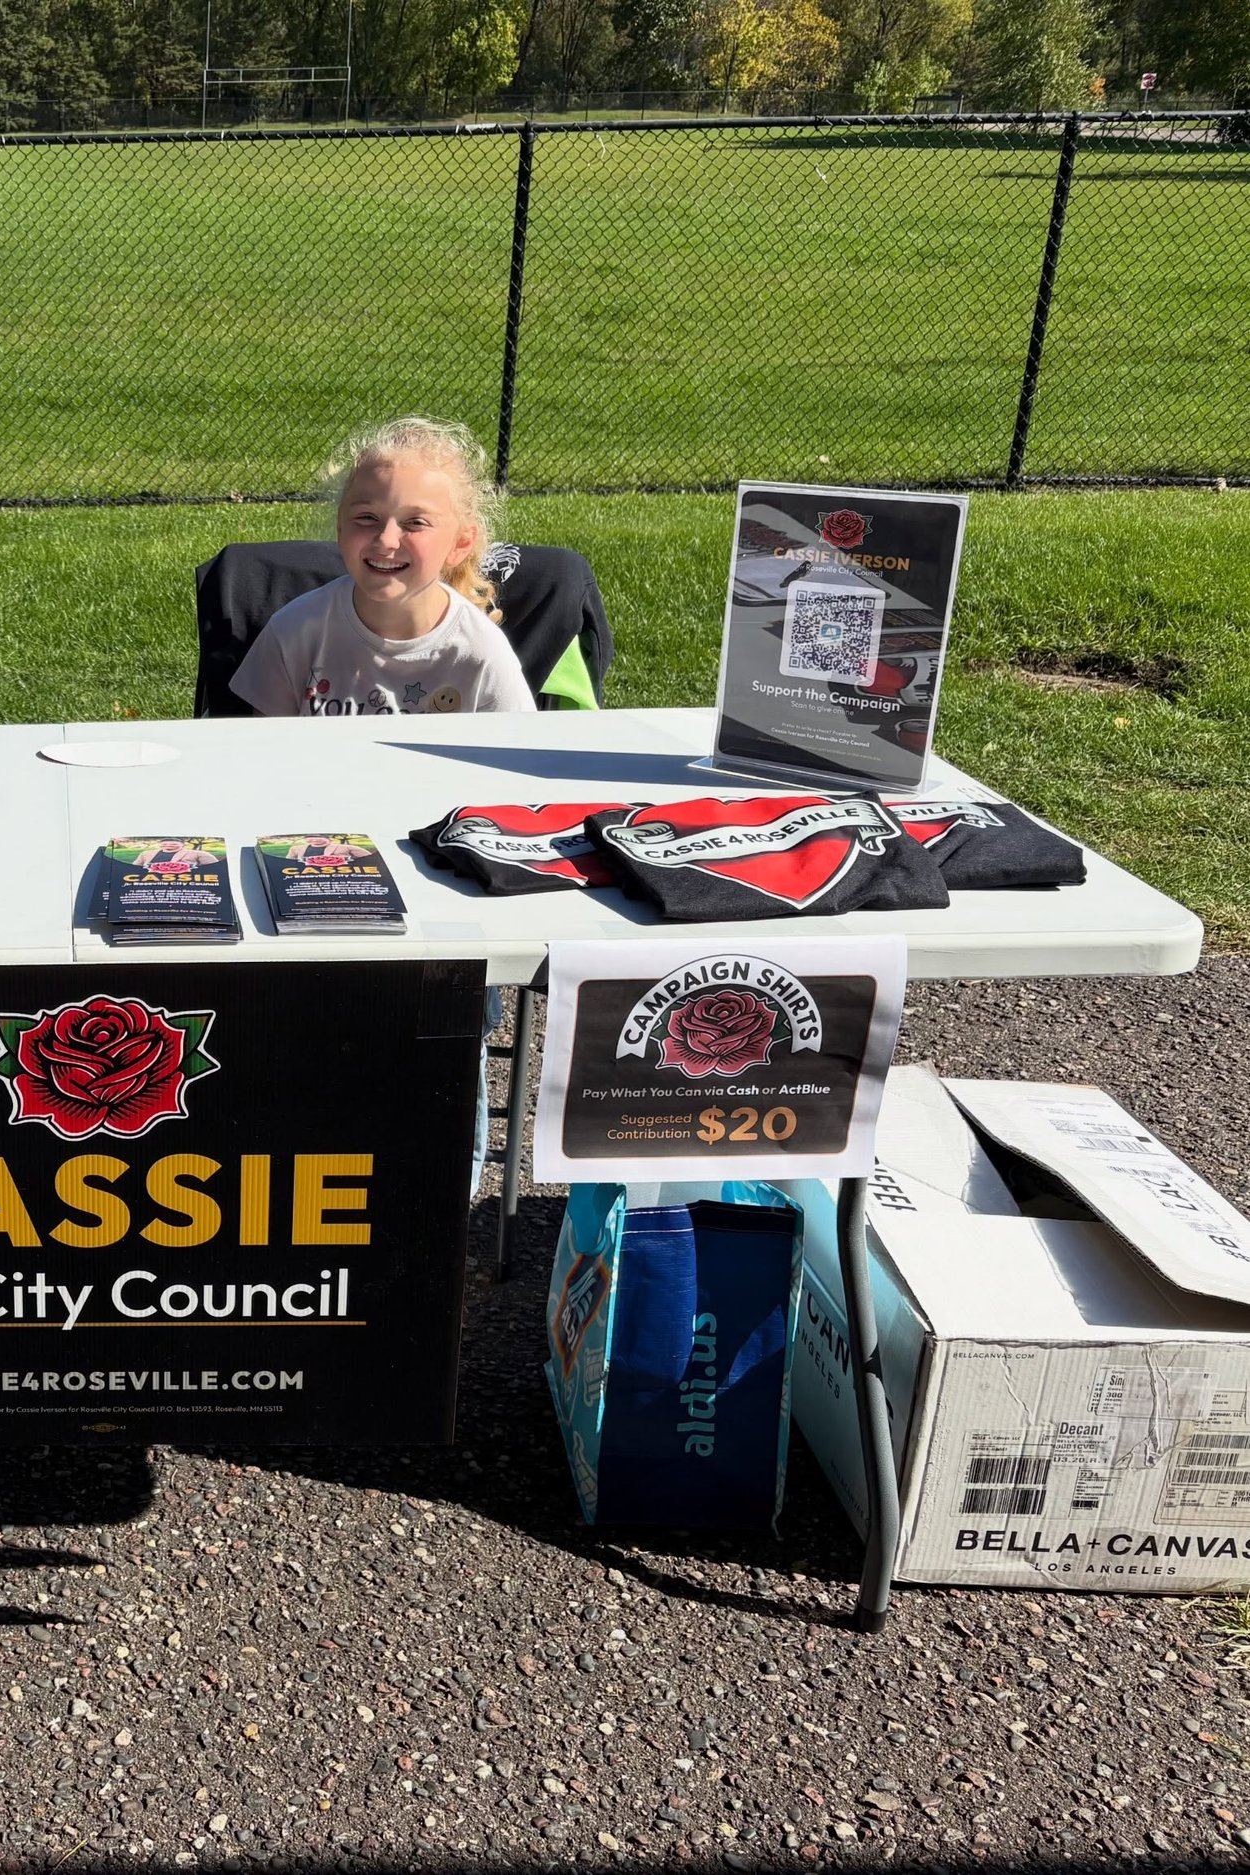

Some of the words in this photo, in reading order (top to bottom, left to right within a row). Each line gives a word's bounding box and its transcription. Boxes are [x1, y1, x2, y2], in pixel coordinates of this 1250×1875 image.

[773, 547, 830, 563] CASSIE
[834, 552, 910, 571] IVERSON
[855, 568, 883, 578] Council
[752, 680, 802, 698] Support
[805, 689, 827, 701] the
[829, 692, 901, 713] Campaign
[479, 839, 549, 854] CASSIE
[282, 866, 381, 875] CASSIE
[123, 874, 220, 883] CASSIE
[623, 961, 751, 1046] CAMPAIGN
[756, 967, 820, 1041] SHIRTS
[582, 1088, 608, 1101] Pay
[610, 1087, 648, 1098] What
[650, 1086, 673, 1098] You
[675, 1086, 702, 1097] Can
[704, 1086, 724, 1097] via
[726, 1085, 759, 1096] Cash
[762, 1087, 777, 1096] or
[778, 1084, 831, 1096] ActBlue
[607, 1127, 691, 1140] Contribution
[696, 1104, 798, 1146] $20
[620, 1113, 693, 1128] Suggested
[111, 1268, 349, 1319] Council
[676, 1311, 718, 1457] aldi.us
[5, 1406, 15, 1415] by
[112, 1405, 128, 1414] City
[128, 1405, 156, 1413] Council
[176, 1405, 191, 1413] Box
[249, 1405, 263, 1413] MN
[263, 1405, 283, 1413] 55113
[1059, 1422, 1104, 1436] Decant
[1034, 1562, 1073, 1573] LOS
[1086, 1564, 1178, 1576] ANGELES
